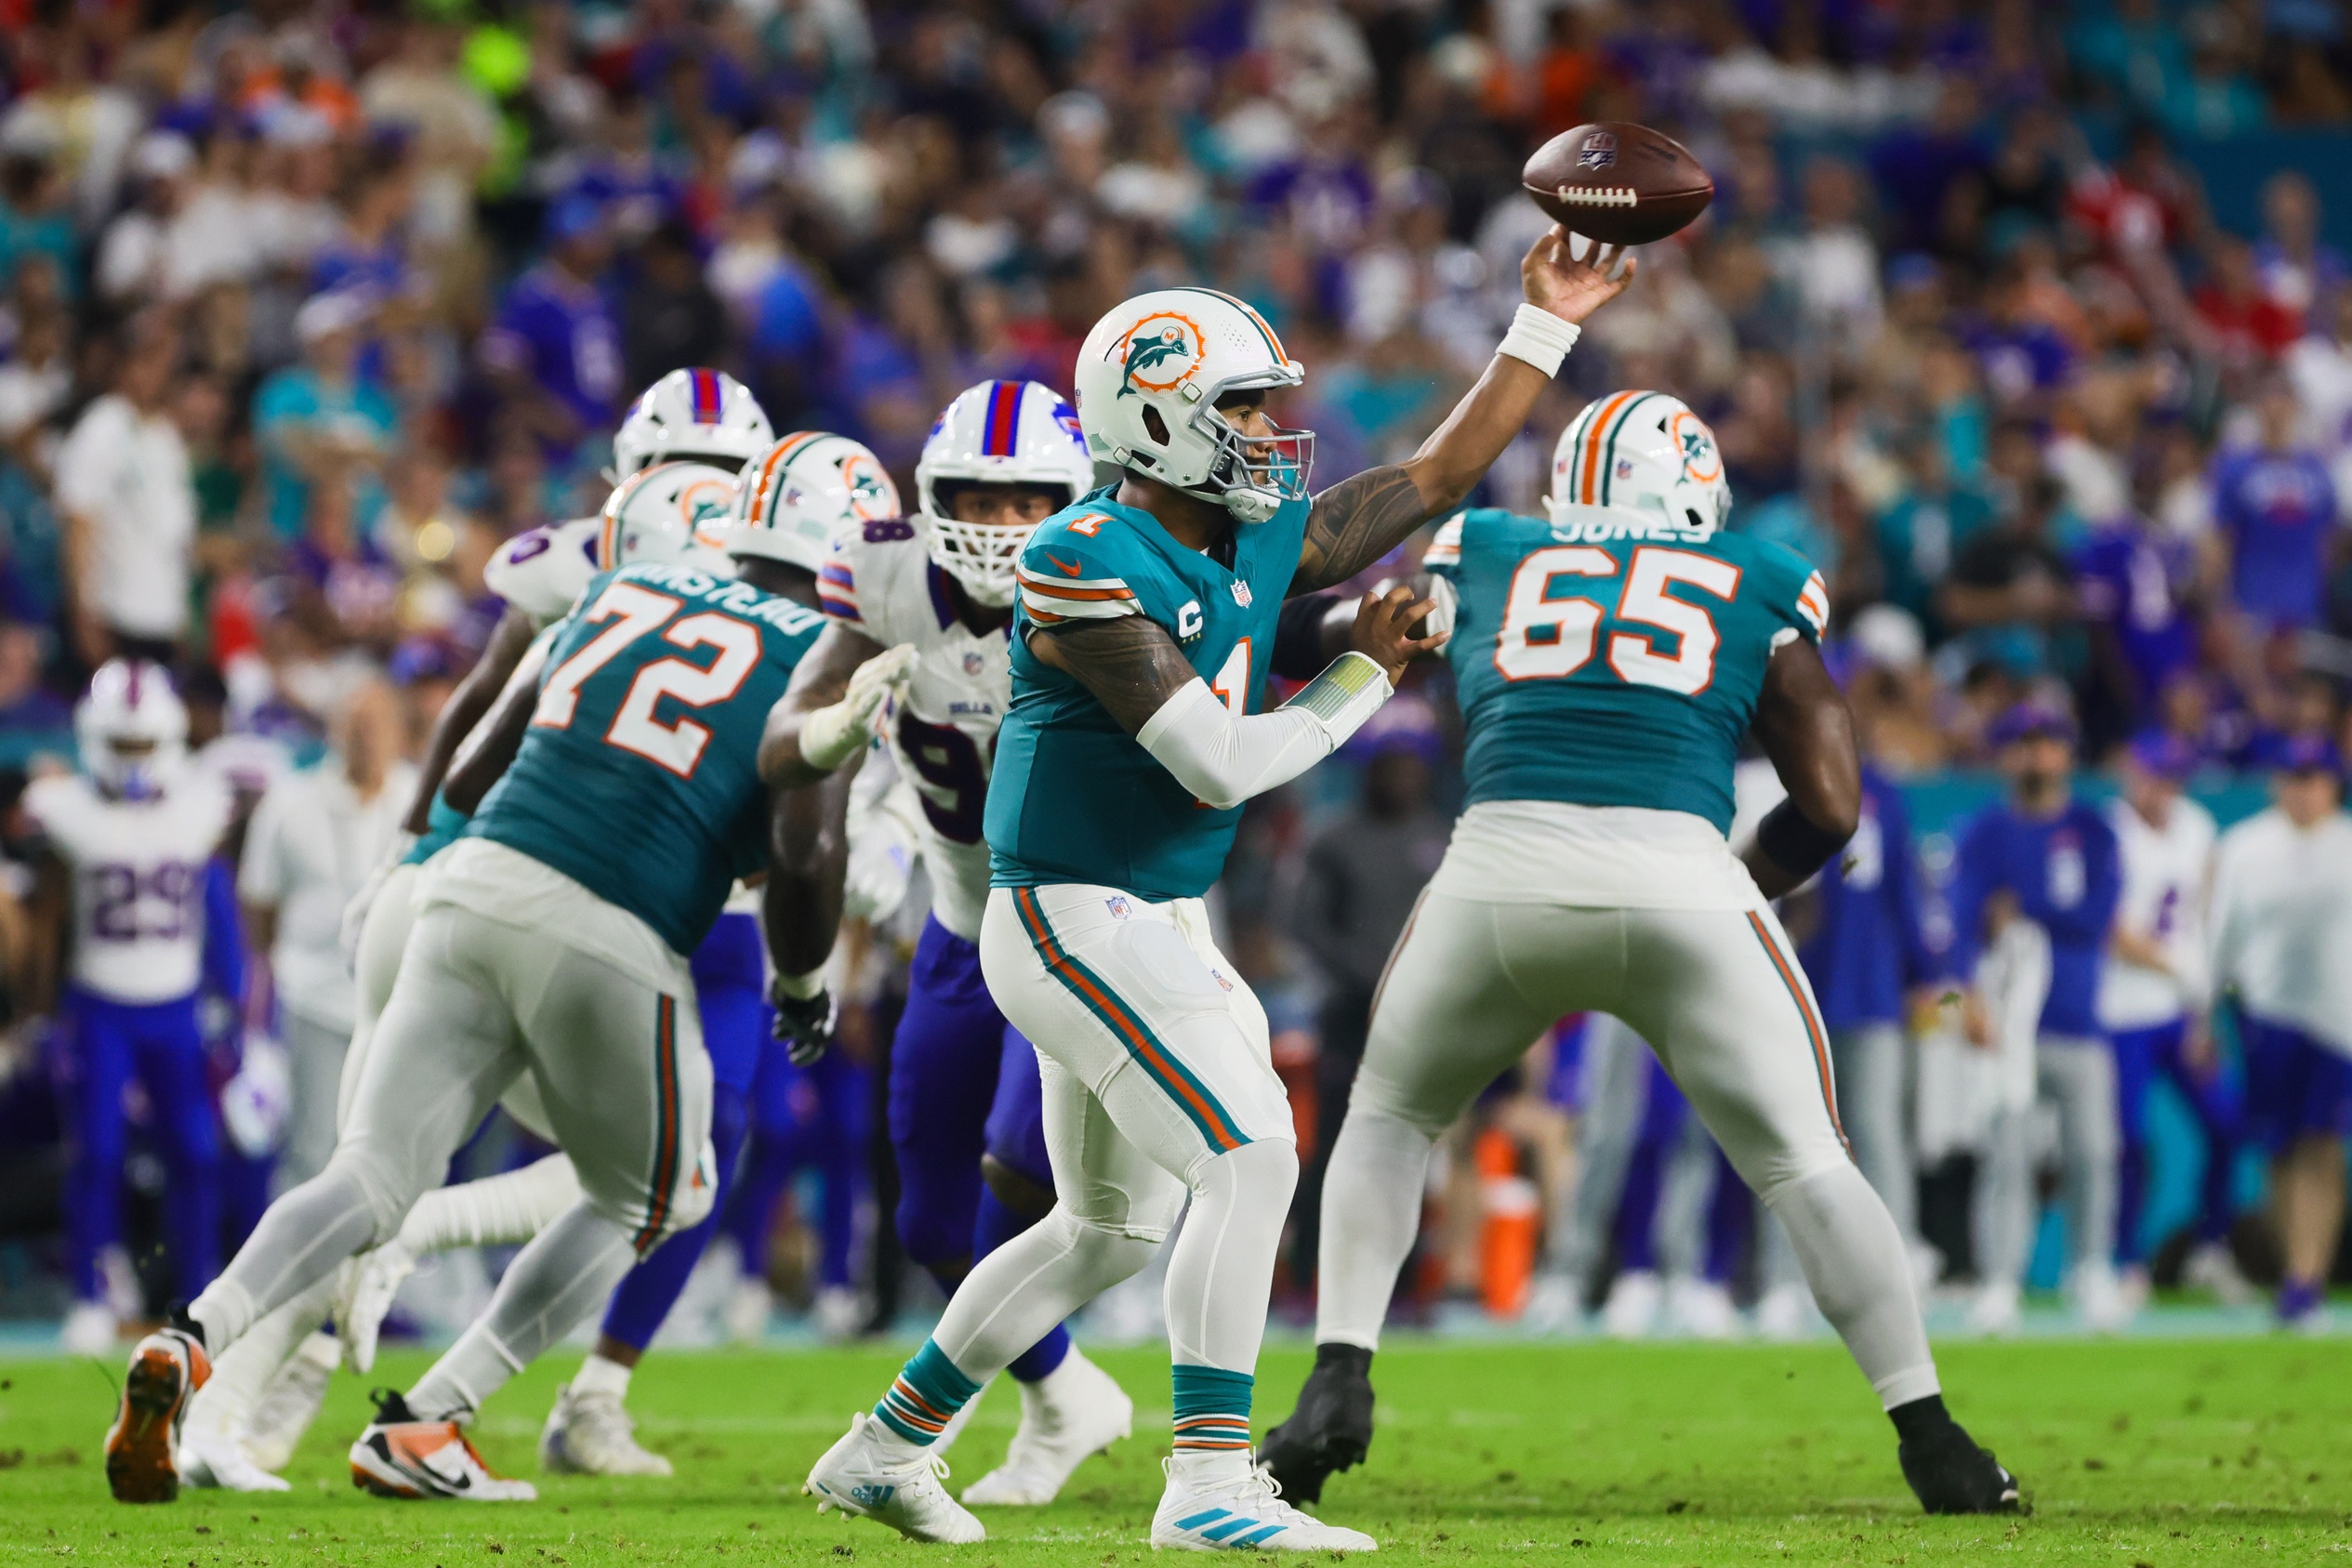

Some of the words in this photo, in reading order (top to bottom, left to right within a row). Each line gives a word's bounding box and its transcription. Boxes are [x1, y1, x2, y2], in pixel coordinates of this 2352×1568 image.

[1164, 332, 1175, 341] M
[1066, 513, 1117, 538] 1
[1178, 600, 1204, 639] C
[1493, 545, 1743, 696] 65
[532, 581, 764, 781] 72
[898, 706, 1003, 846] 9
